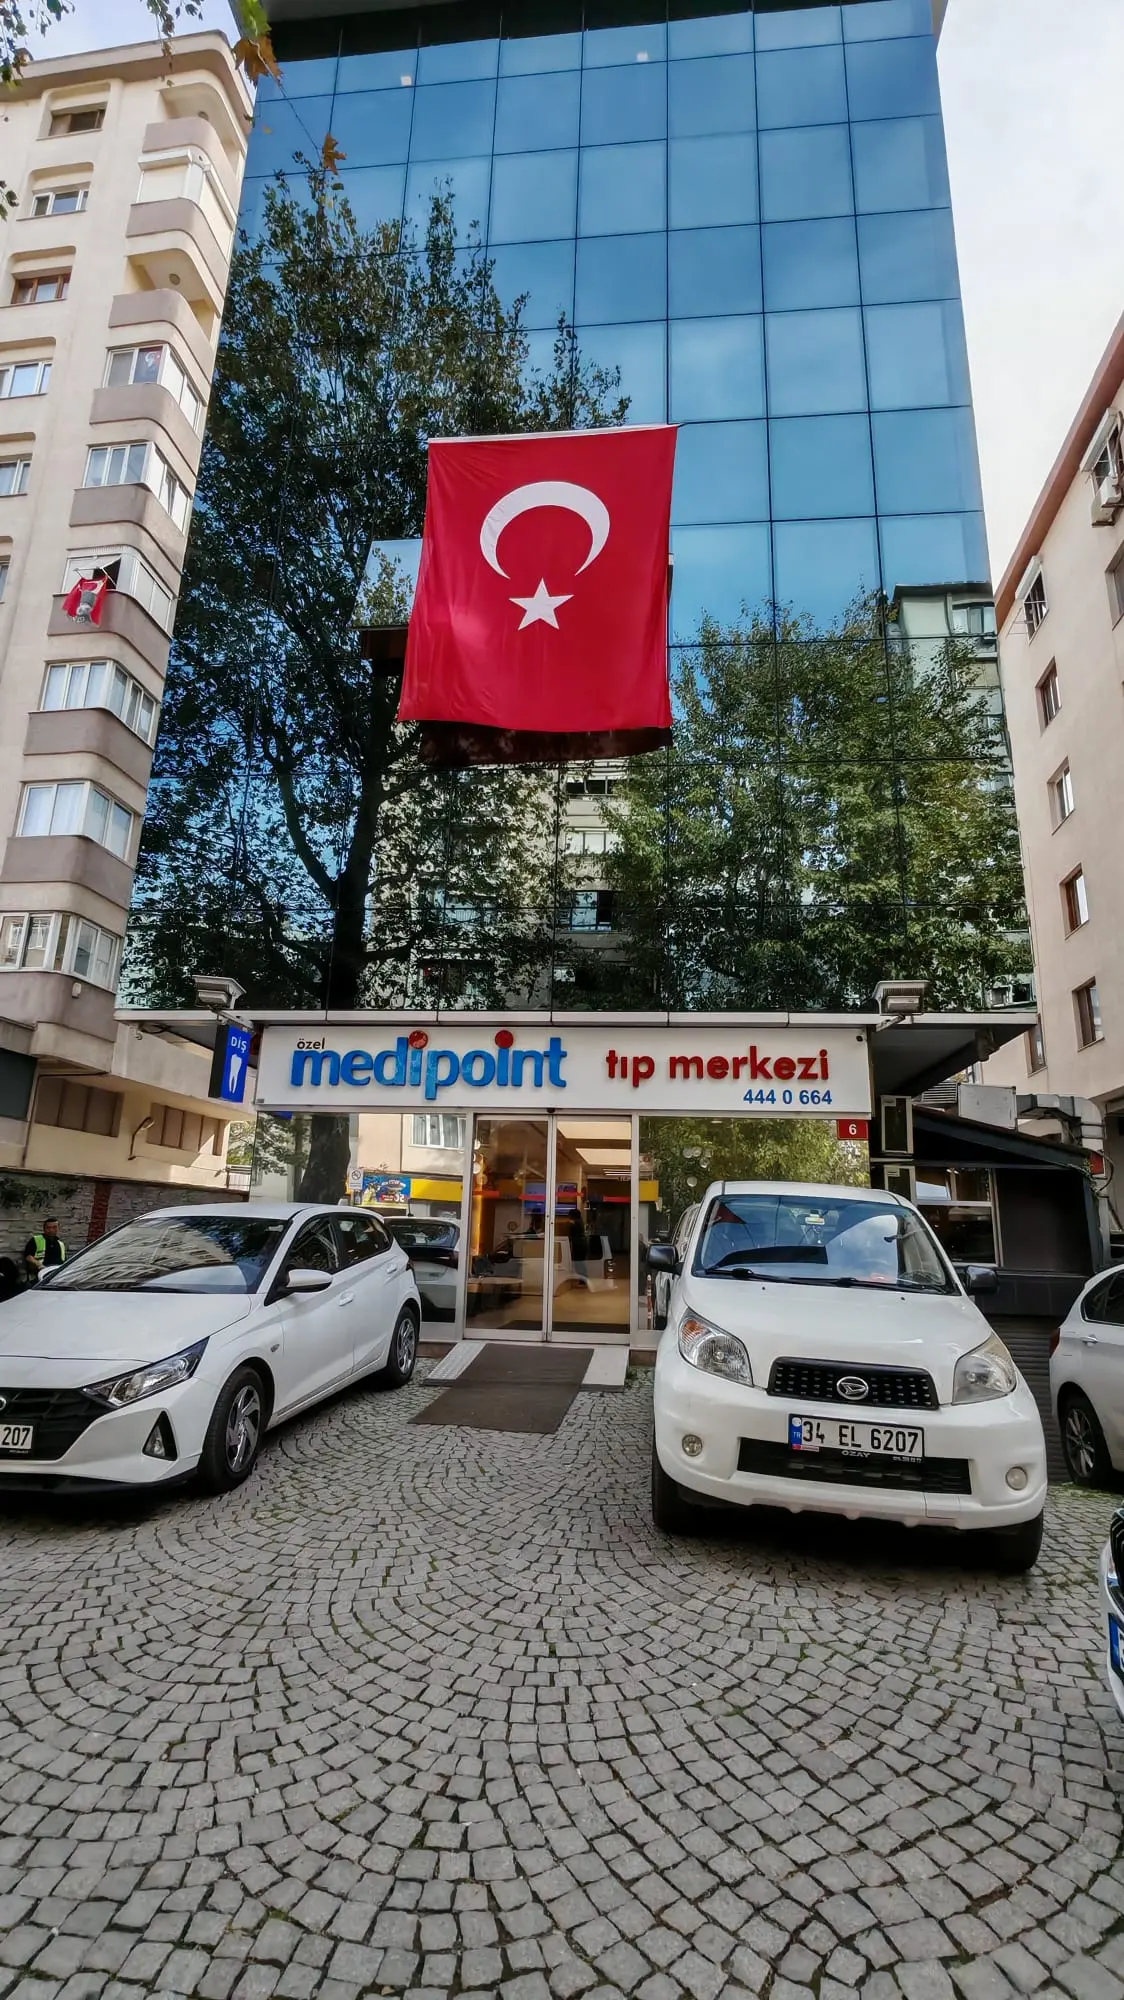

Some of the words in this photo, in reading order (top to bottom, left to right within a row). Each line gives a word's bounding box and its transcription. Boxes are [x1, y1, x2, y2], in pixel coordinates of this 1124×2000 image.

[231, 1036, 248, 1054] DİŞ
[296, 1038, 325, 1050] özel
[290, 1030, 567, 1100] medipoint
[606, 1050, 655, 1088] tıp
[669, 1045, 829, 1080] merkezi
[743, 1089, 777, 1105] 444
[782, 1090, 793, 1105] 0
[799, 1089, 833, 1105] 664
[848, 1124, 857, 1135] 6
[803, 1421, 825, 1444] 34
[839, 1425, 862, 1448] EL
[871, 1428, 919, 1454] 6207
